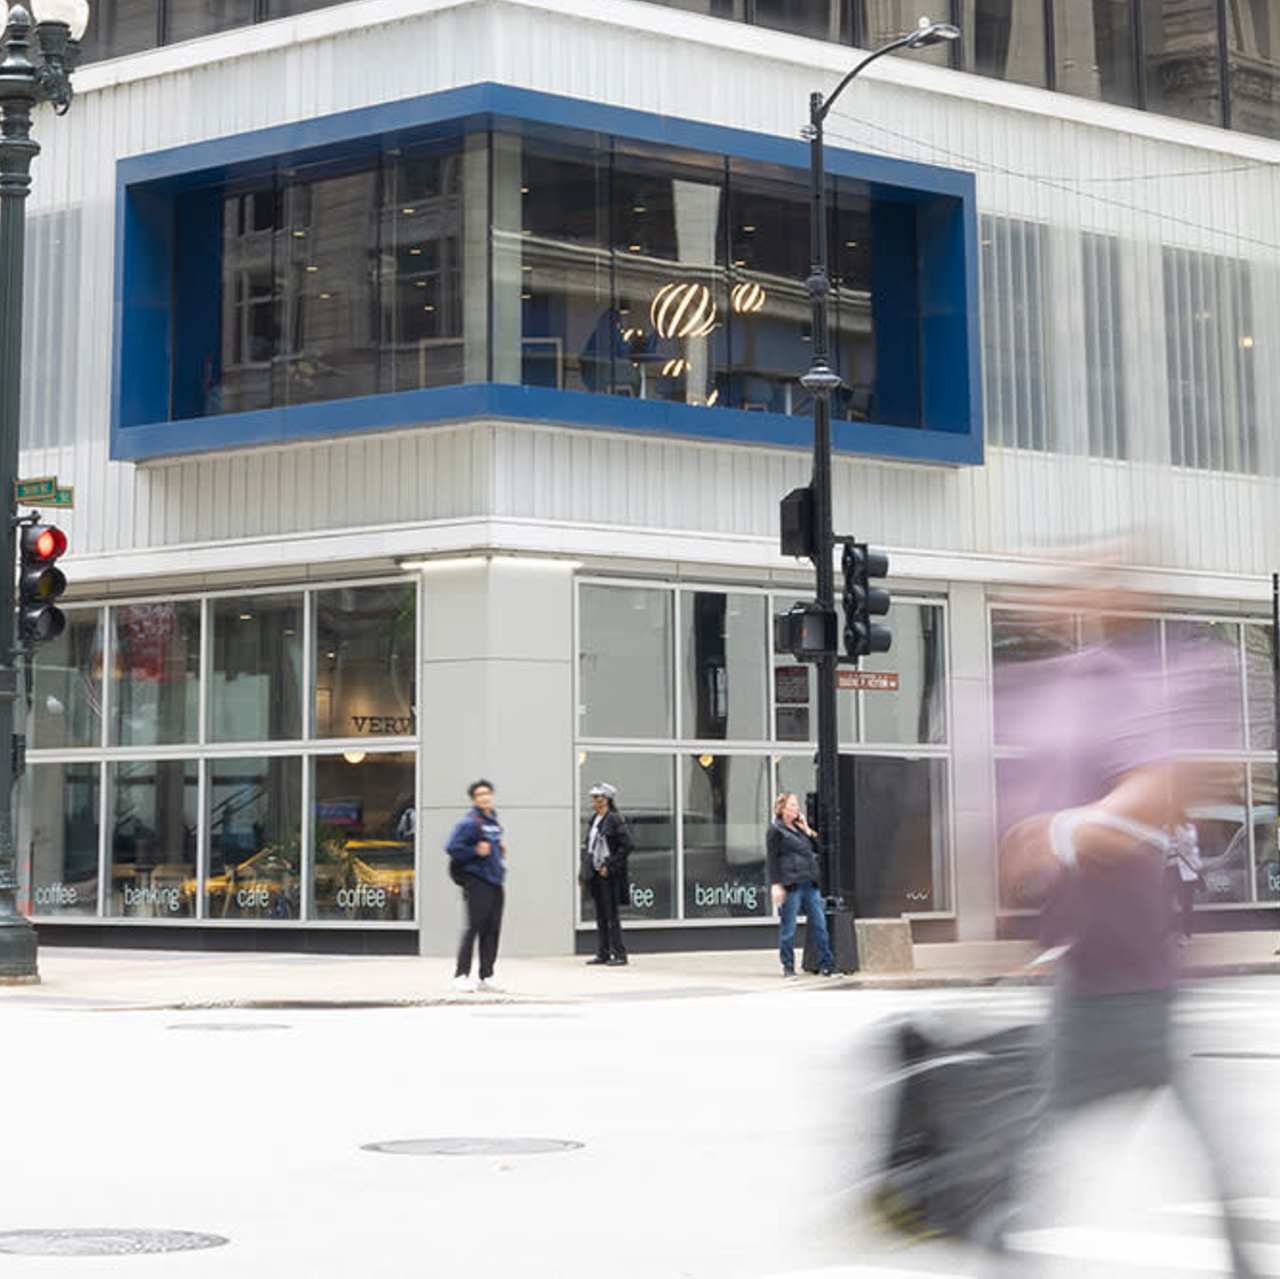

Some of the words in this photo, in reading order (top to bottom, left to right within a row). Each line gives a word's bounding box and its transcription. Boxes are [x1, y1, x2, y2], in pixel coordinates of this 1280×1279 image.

[35, 883, 78, 905] coffee
[124, 885, 181, 912] banking
[237, 883, 270, 907] café
[337, 882, 386, 908] coffee
[695, 882, 758, 910] banking
